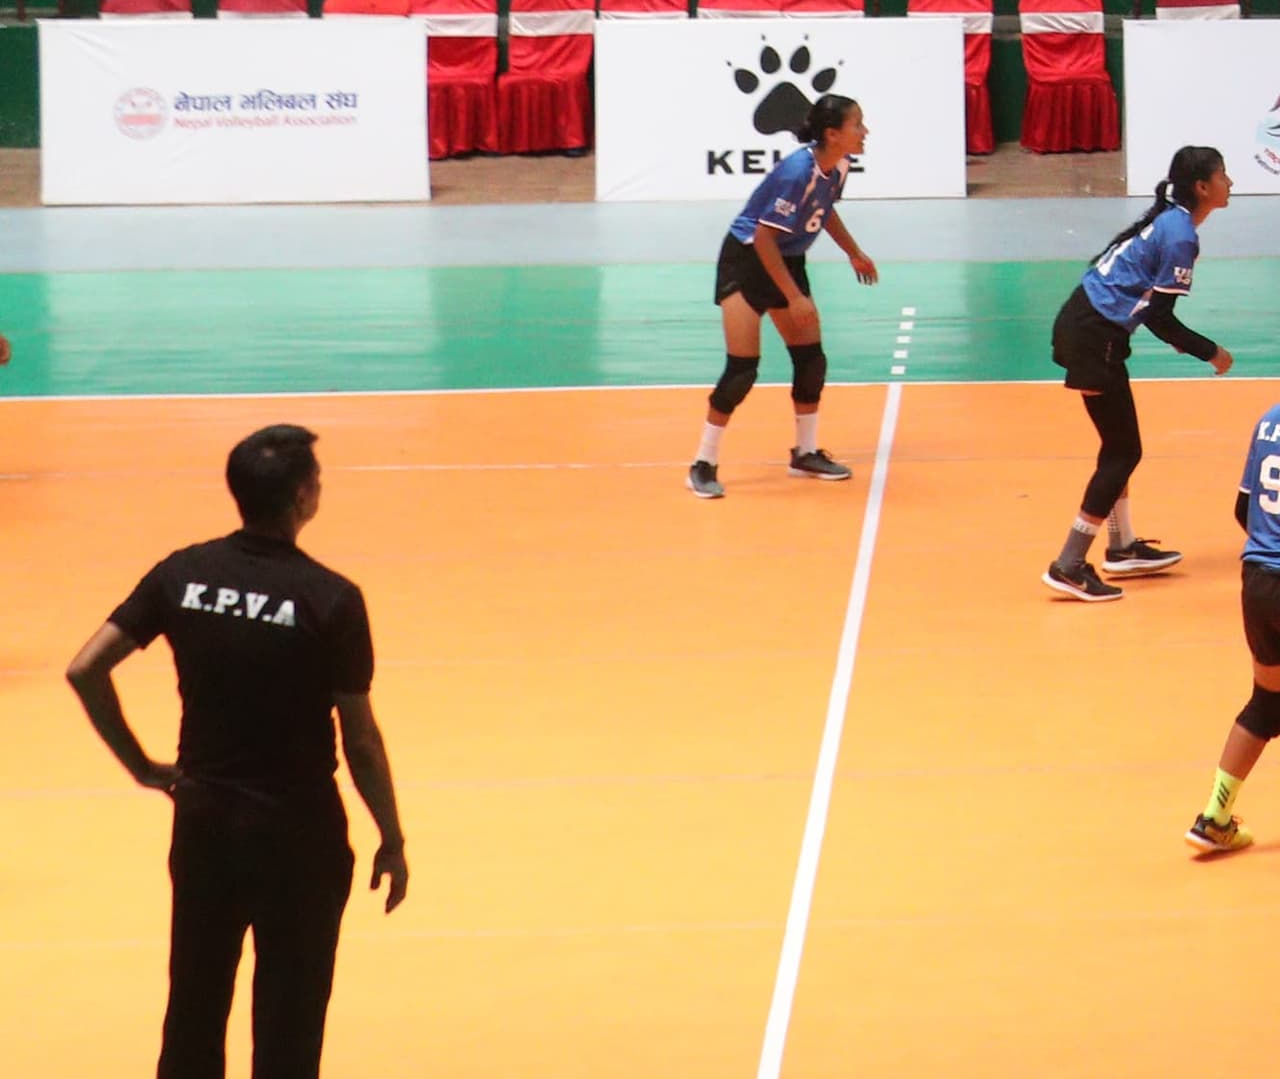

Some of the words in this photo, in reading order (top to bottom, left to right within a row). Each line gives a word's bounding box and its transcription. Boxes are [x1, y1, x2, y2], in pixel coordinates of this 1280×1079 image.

[173, 90, 231, 112] नेपाल
[325, 89, 358, 110] संघ
[805, 208, 825, 234] 6
[180, 581, 297, 627] K.P.V.A
